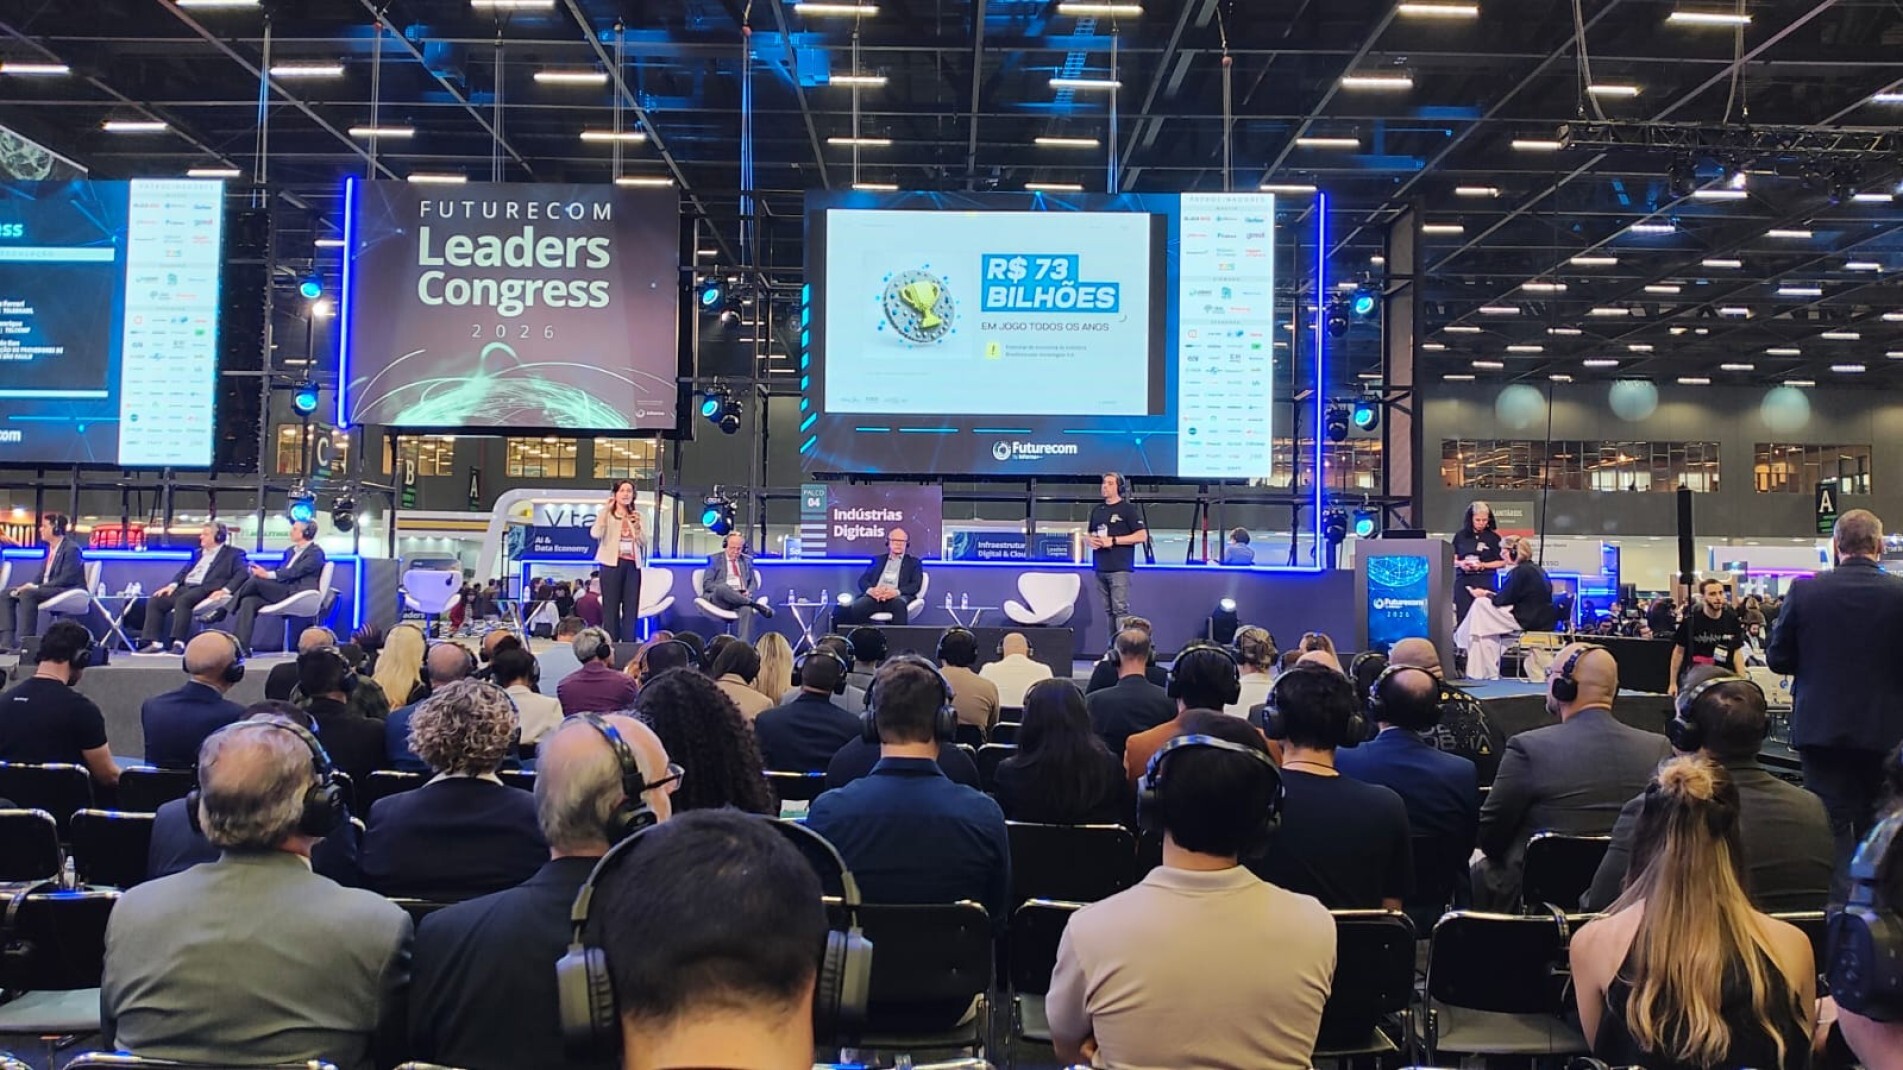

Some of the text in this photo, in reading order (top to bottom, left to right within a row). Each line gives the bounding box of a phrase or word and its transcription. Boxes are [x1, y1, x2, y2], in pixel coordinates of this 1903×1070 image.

[419, 201, 612, 220] FUTURECOM
[0, 224, 23, 237] ss
[418, 226, 611, 268] Leaders
[987, 256, 1069, 284] R$ 73
[418, 270, 610, 317] Congress
[986, 280, 1116, 309] BILHÕES
[471, 325, 554, 338] 2026
[981, 322, 1110, 331] EM JOGO TODOS OS ANOS
[316, 437, 329, 466] C
[1012, 441, 1078, 454] Futurecom
[405, 459, 415, 485] B
[470, 476, 479, 498] A
[807, 497, 820, 507] 04
[1819, 490, 1834, 512] A
[833, 508, 903, 520] Indústrias
[833, 524, 885, 540] Digitais
[535, 536, 552, 544] AI &
[978, 541, 1026, 549] Infraestrutur
[535, 544, 589, 554] Data Economy
[1010, 550, 1026, 558] Clou
